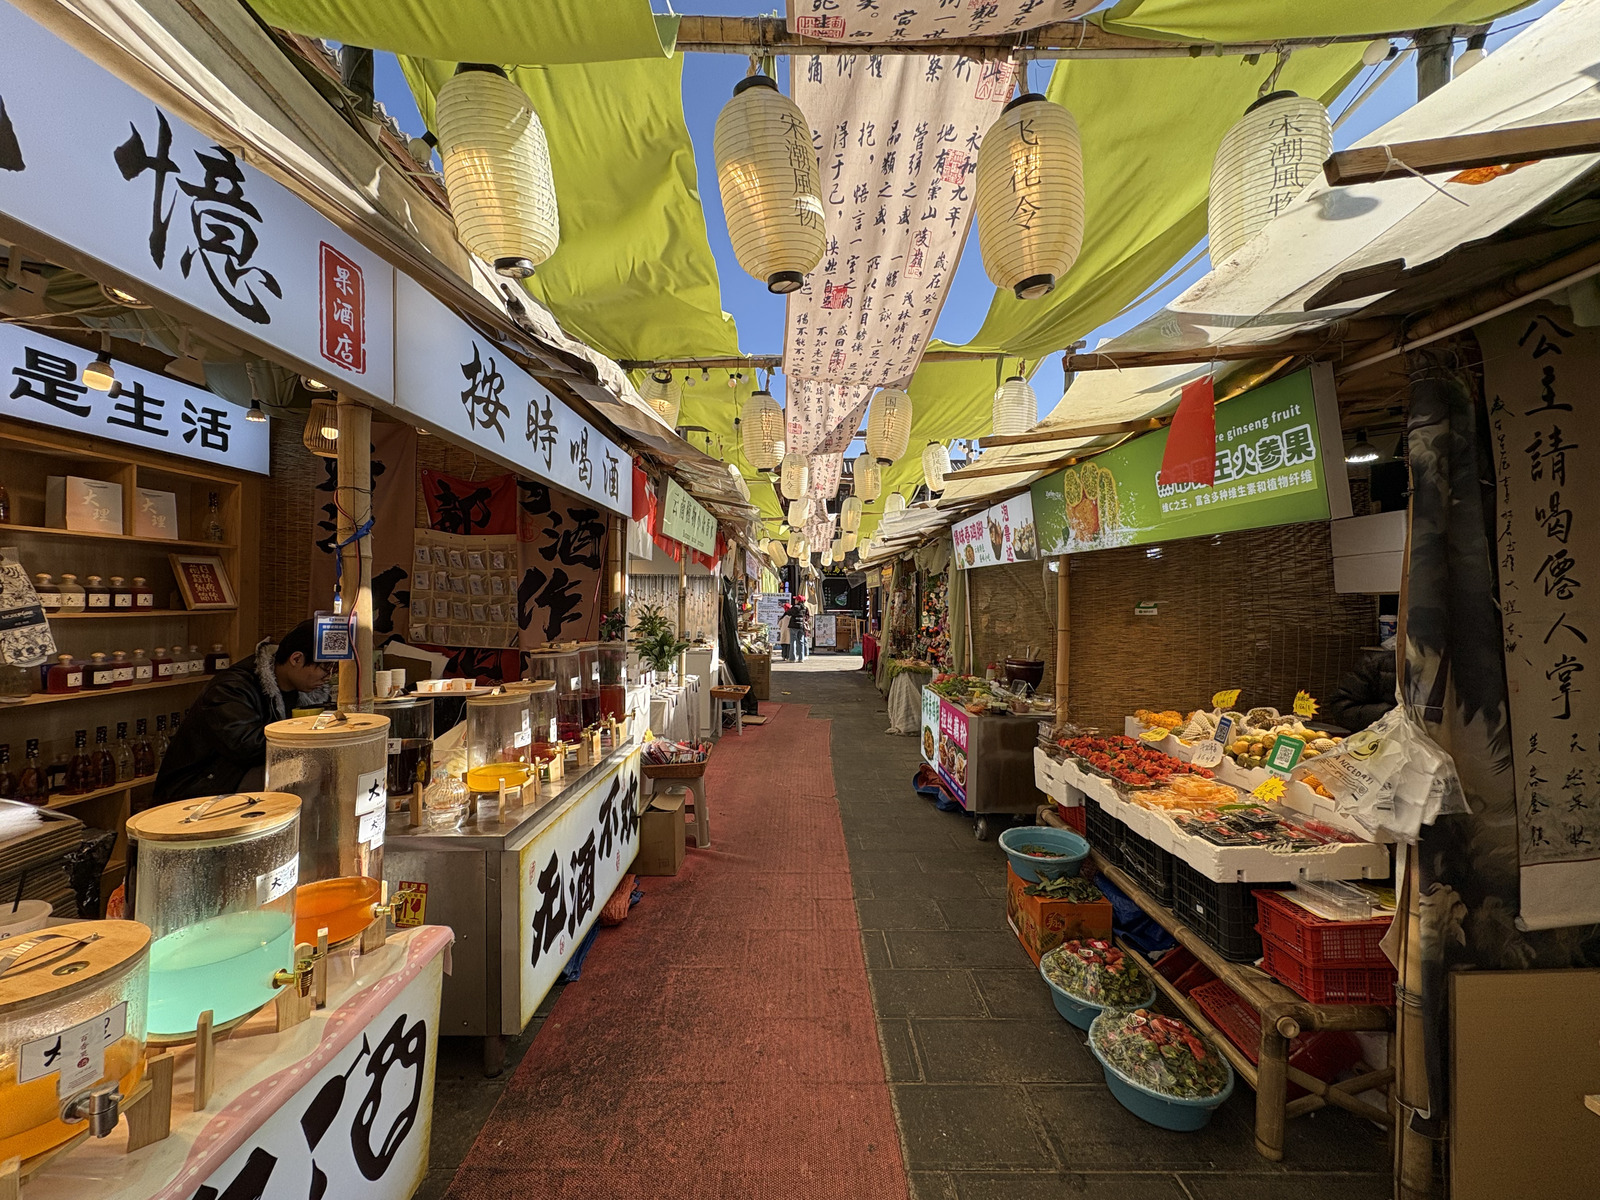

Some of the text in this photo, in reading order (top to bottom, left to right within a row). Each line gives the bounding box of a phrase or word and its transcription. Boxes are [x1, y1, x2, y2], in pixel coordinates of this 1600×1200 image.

[1005, 118, 1042, 230] 飞花令
[332, 265, 355, 367] 果酒店
[10, 345, 232, 453] 是生活
[459, 342, 621, 503] 按時喝酒
[1226, 417, 1269, 441] ginseng
[1271, 404, 1301, 424] fruit
